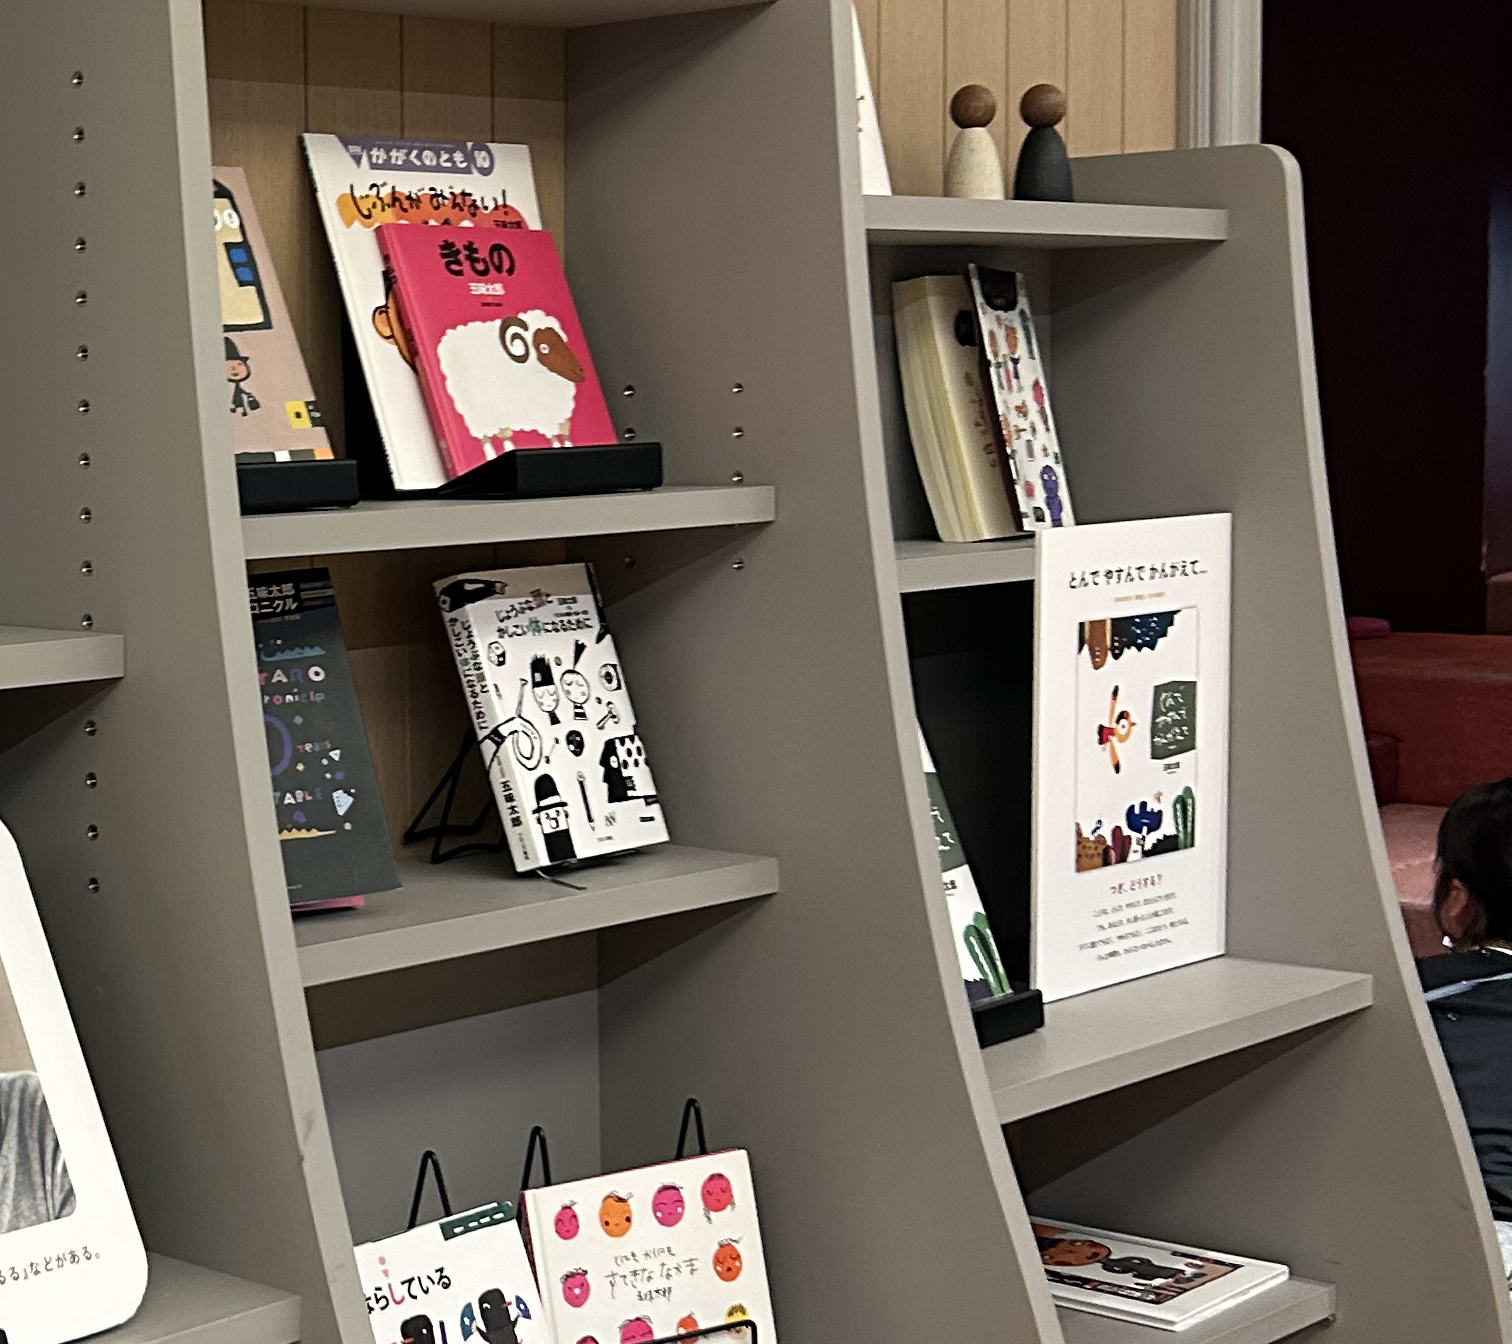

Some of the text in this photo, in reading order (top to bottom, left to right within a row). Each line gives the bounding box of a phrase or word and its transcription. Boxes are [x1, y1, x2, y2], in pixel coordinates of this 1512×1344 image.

[369, 146, 468, 169] かがくのとも
[438, 239, 516, 278] きもの
